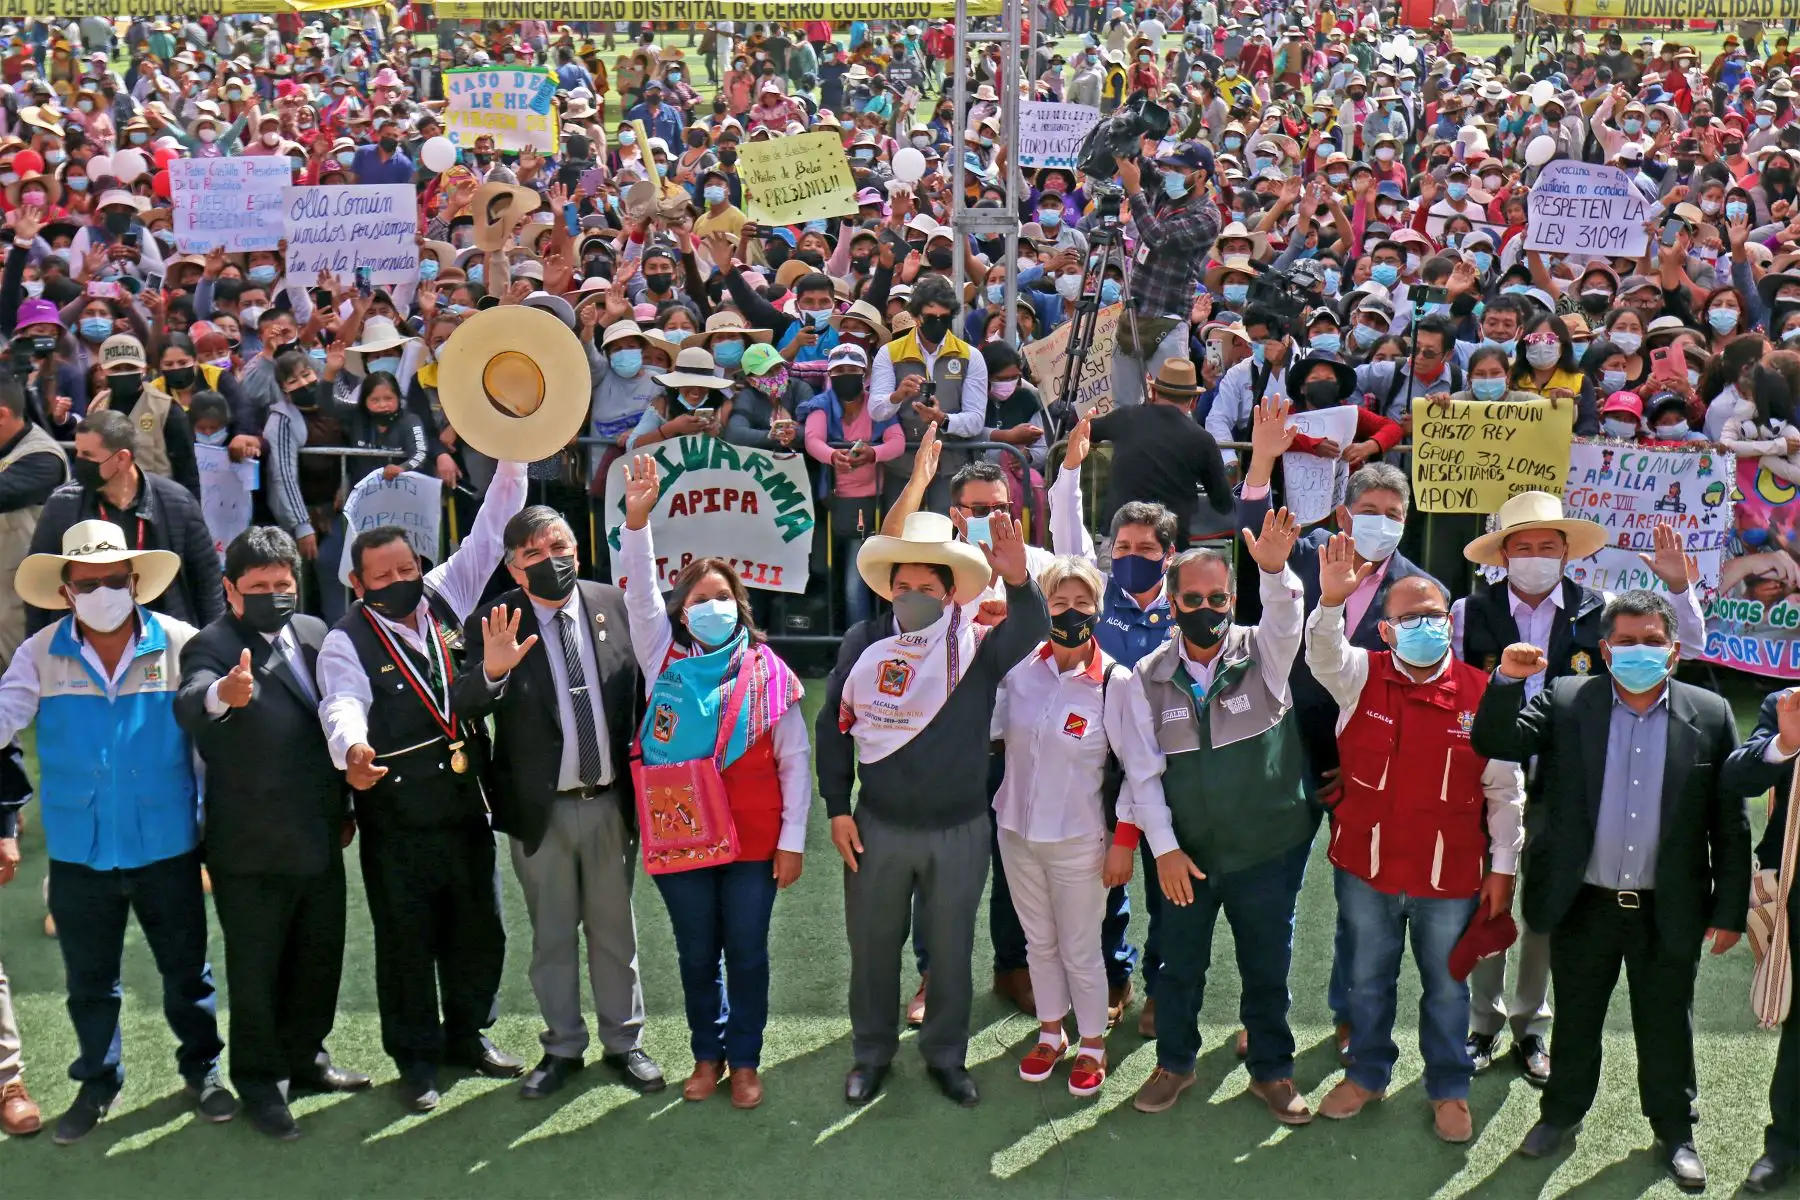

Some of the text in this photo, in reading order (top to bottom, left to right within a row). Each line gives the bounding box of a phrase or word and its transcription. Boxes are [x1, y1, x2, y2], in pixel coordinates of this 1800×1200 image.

[34, 0, 55, 14] DE
[61, 0, 120, 14] CERRO
[128, 0, 223, 14] COLORADO
[483, 0, 931, 20] MUNICIPALIDAD DISTRITAL DE CERRO COLORADO
[1624, 0, 1800, 18] MUNICIPALIDAD DI
[470, 92, 528, 109] LECHE
[1533, 194, 1645, 221] RESPETEN LA
[1575, 225, 1628, 249] 31091
[1484, 403, 1543, 422] COMÚN
[1421, 421, 1517, 442] CRISTO REY
[1418, 441, 1556, 482] GRUPO 32 LOMAS
[1418, 463, 1505, 482] NESESITAMOS
[668, 487, 758, 518] APIPA
[1419, 487, 1478, 511] APOYO
[1605, 512, 1616, 526] A
[1622, 514, 1699, 529] AREQUIPA
[1618, 530, 1727, 548] BOLRTE
[1106, 616, 1130, 632] ALCALDE
[1770, 601, 1800, 628] de
[1764, 639, 1785, 667] V
[872, 700, 899, 711] ALCALDE
[1365, 709, 1393, 725] ALCALDE
